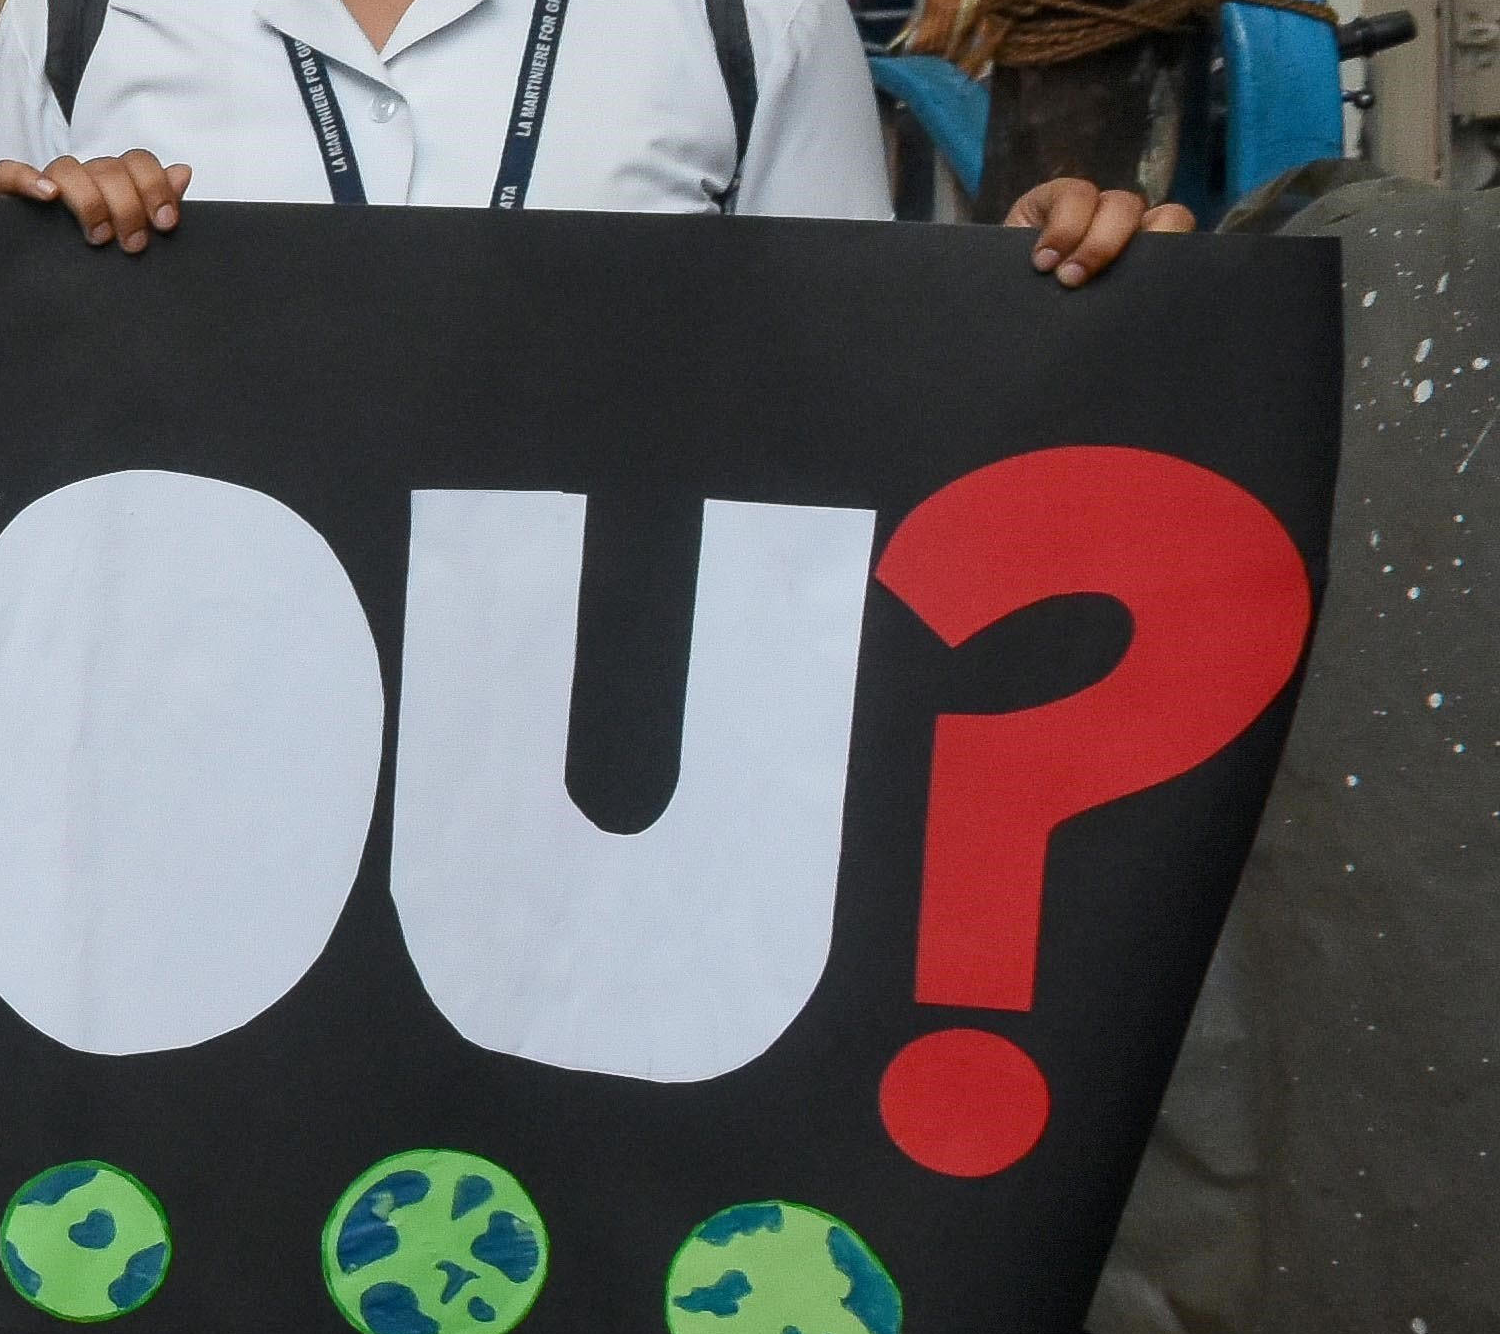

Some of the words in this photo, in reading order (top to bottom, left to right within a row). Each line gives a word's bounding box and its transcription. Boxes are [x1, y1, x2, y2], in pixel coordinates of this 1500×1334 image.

[538, 16, 558, 41] FOR
[301, 58, 321, 85] FOR
[520, 43, 551, 120] MARTINIERE
[308, 84, 345, 158] MARTINIERE
[515, 122, 532, 137] LA
[332, 157, 348, 174] LA
